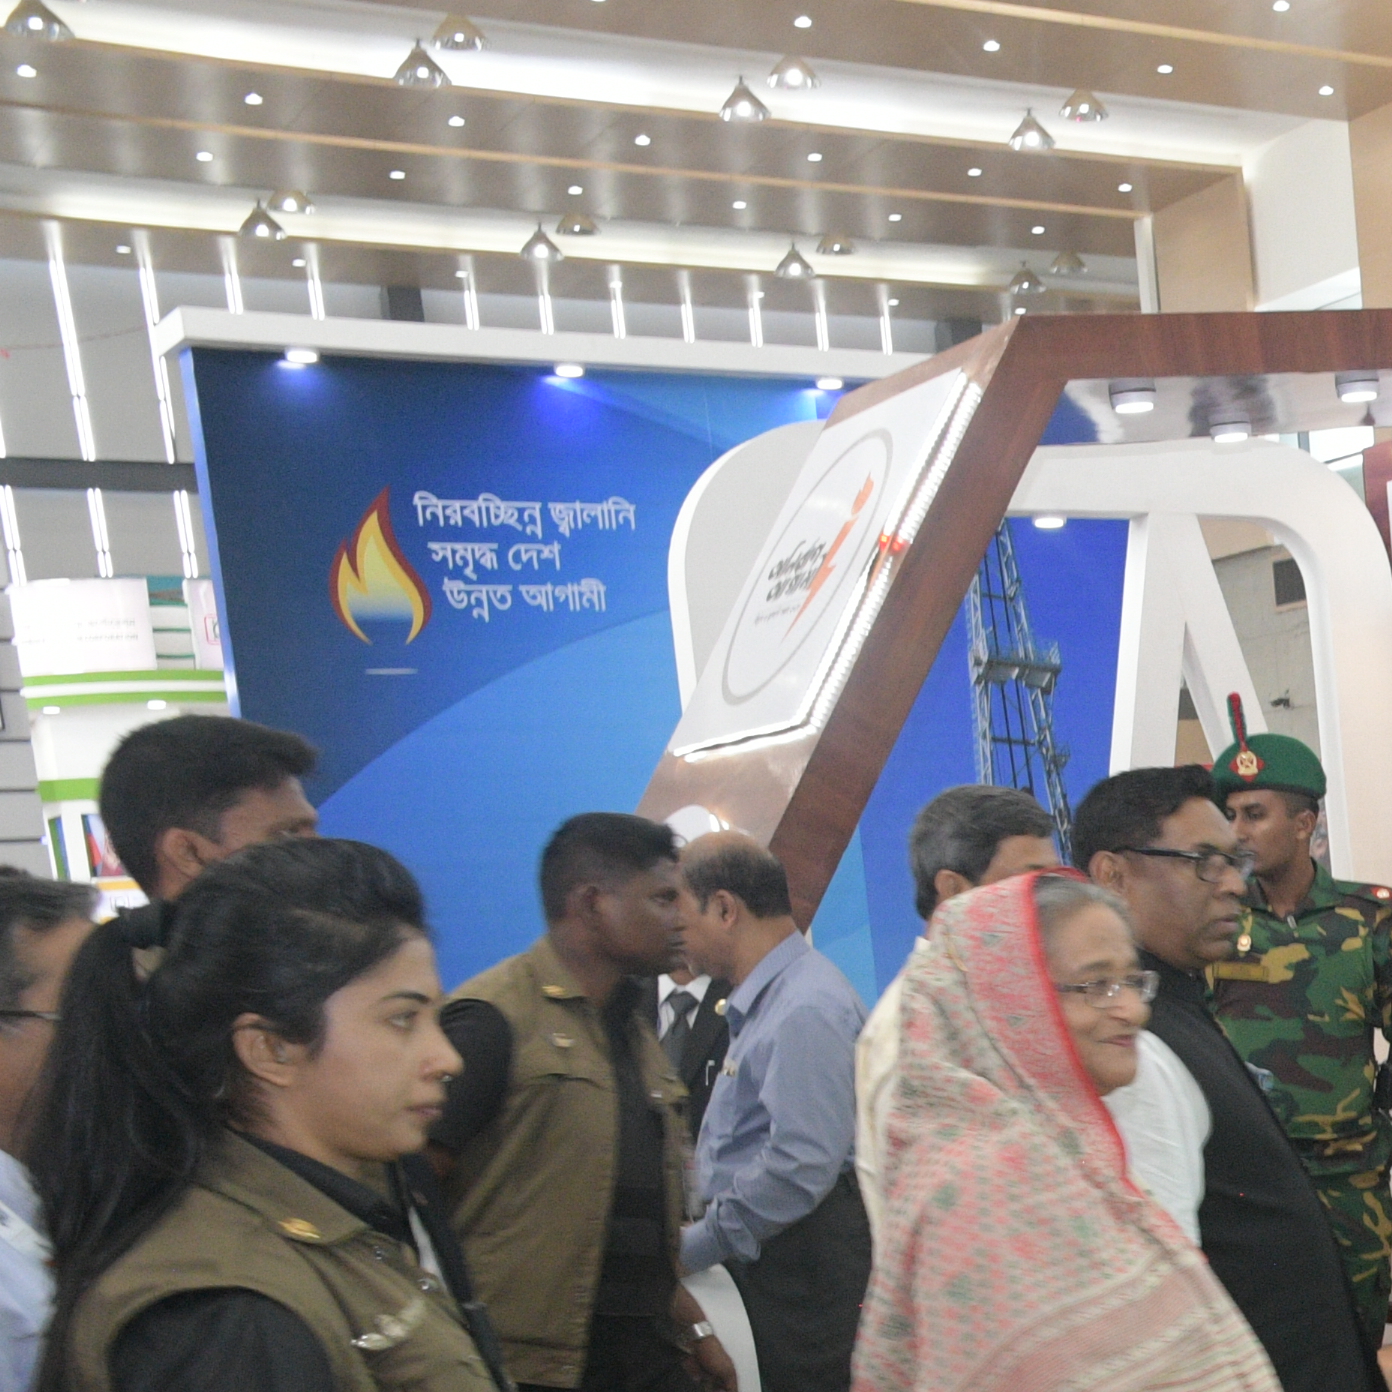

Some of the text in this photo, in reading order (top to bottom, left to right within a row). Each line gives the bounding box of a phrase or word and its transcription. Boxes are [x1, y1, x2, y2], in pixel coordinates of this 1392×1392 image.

[413, 490, 636, 540] নিরবচ্ছিন্ন জ্বালানি
[427, 540, 561, 581] সমৃদ্ধ দেশ
[442, 577, 607, 623] উন্নত আগামী
